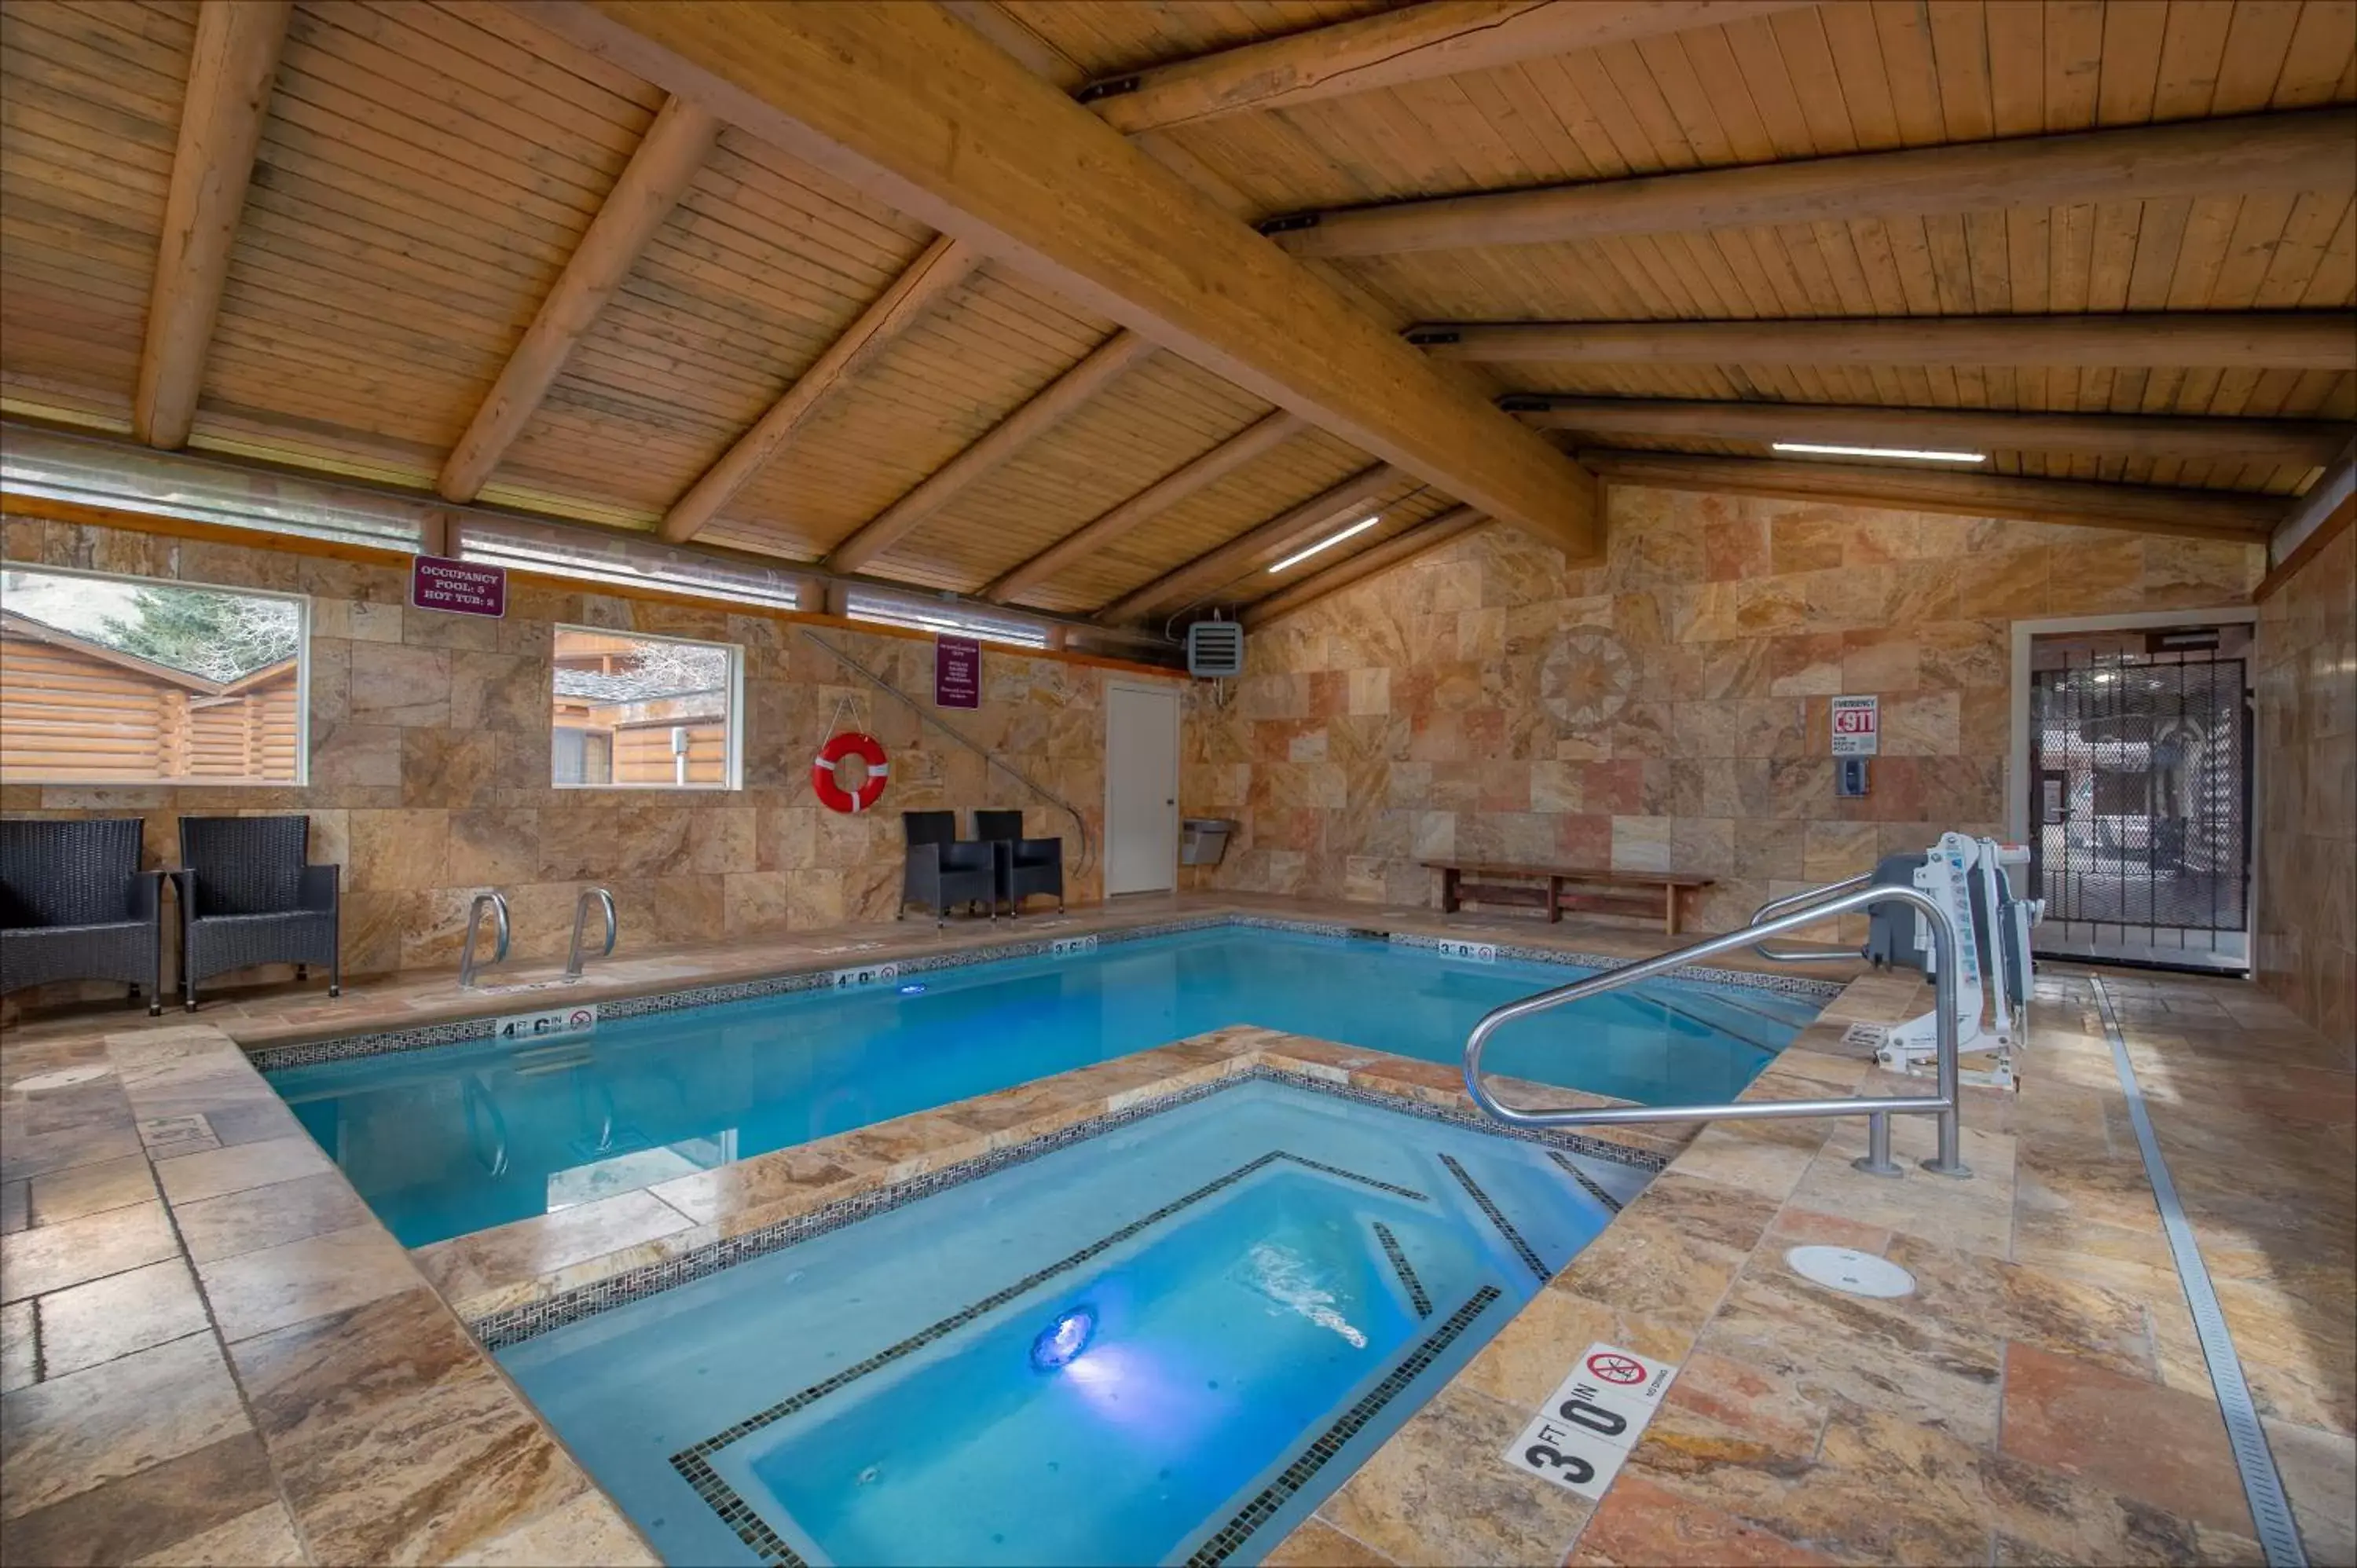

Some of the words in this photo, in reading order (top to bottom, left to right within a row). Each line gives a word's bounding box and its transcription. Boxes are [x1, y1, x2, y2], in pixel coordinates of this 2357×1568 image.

[420, 565, 499, 584] OCCUPANCY
[434, 579, 475, 593] POOL:
[477, 585, 485, 594] 5
[424, 590, 453, 601] HOT
[456, 594, 484, 606] TUB:
[1844, 711, 1874, 731] 911
[503, 1022, 515, 1035] 4
[1571, 1382, 1600, 1401] IN
[1559, 1399, 1627, 1436] 0
[1537, 1423, 1567, 1446] FT
[1525, 1444, 1596, 1484] 3
